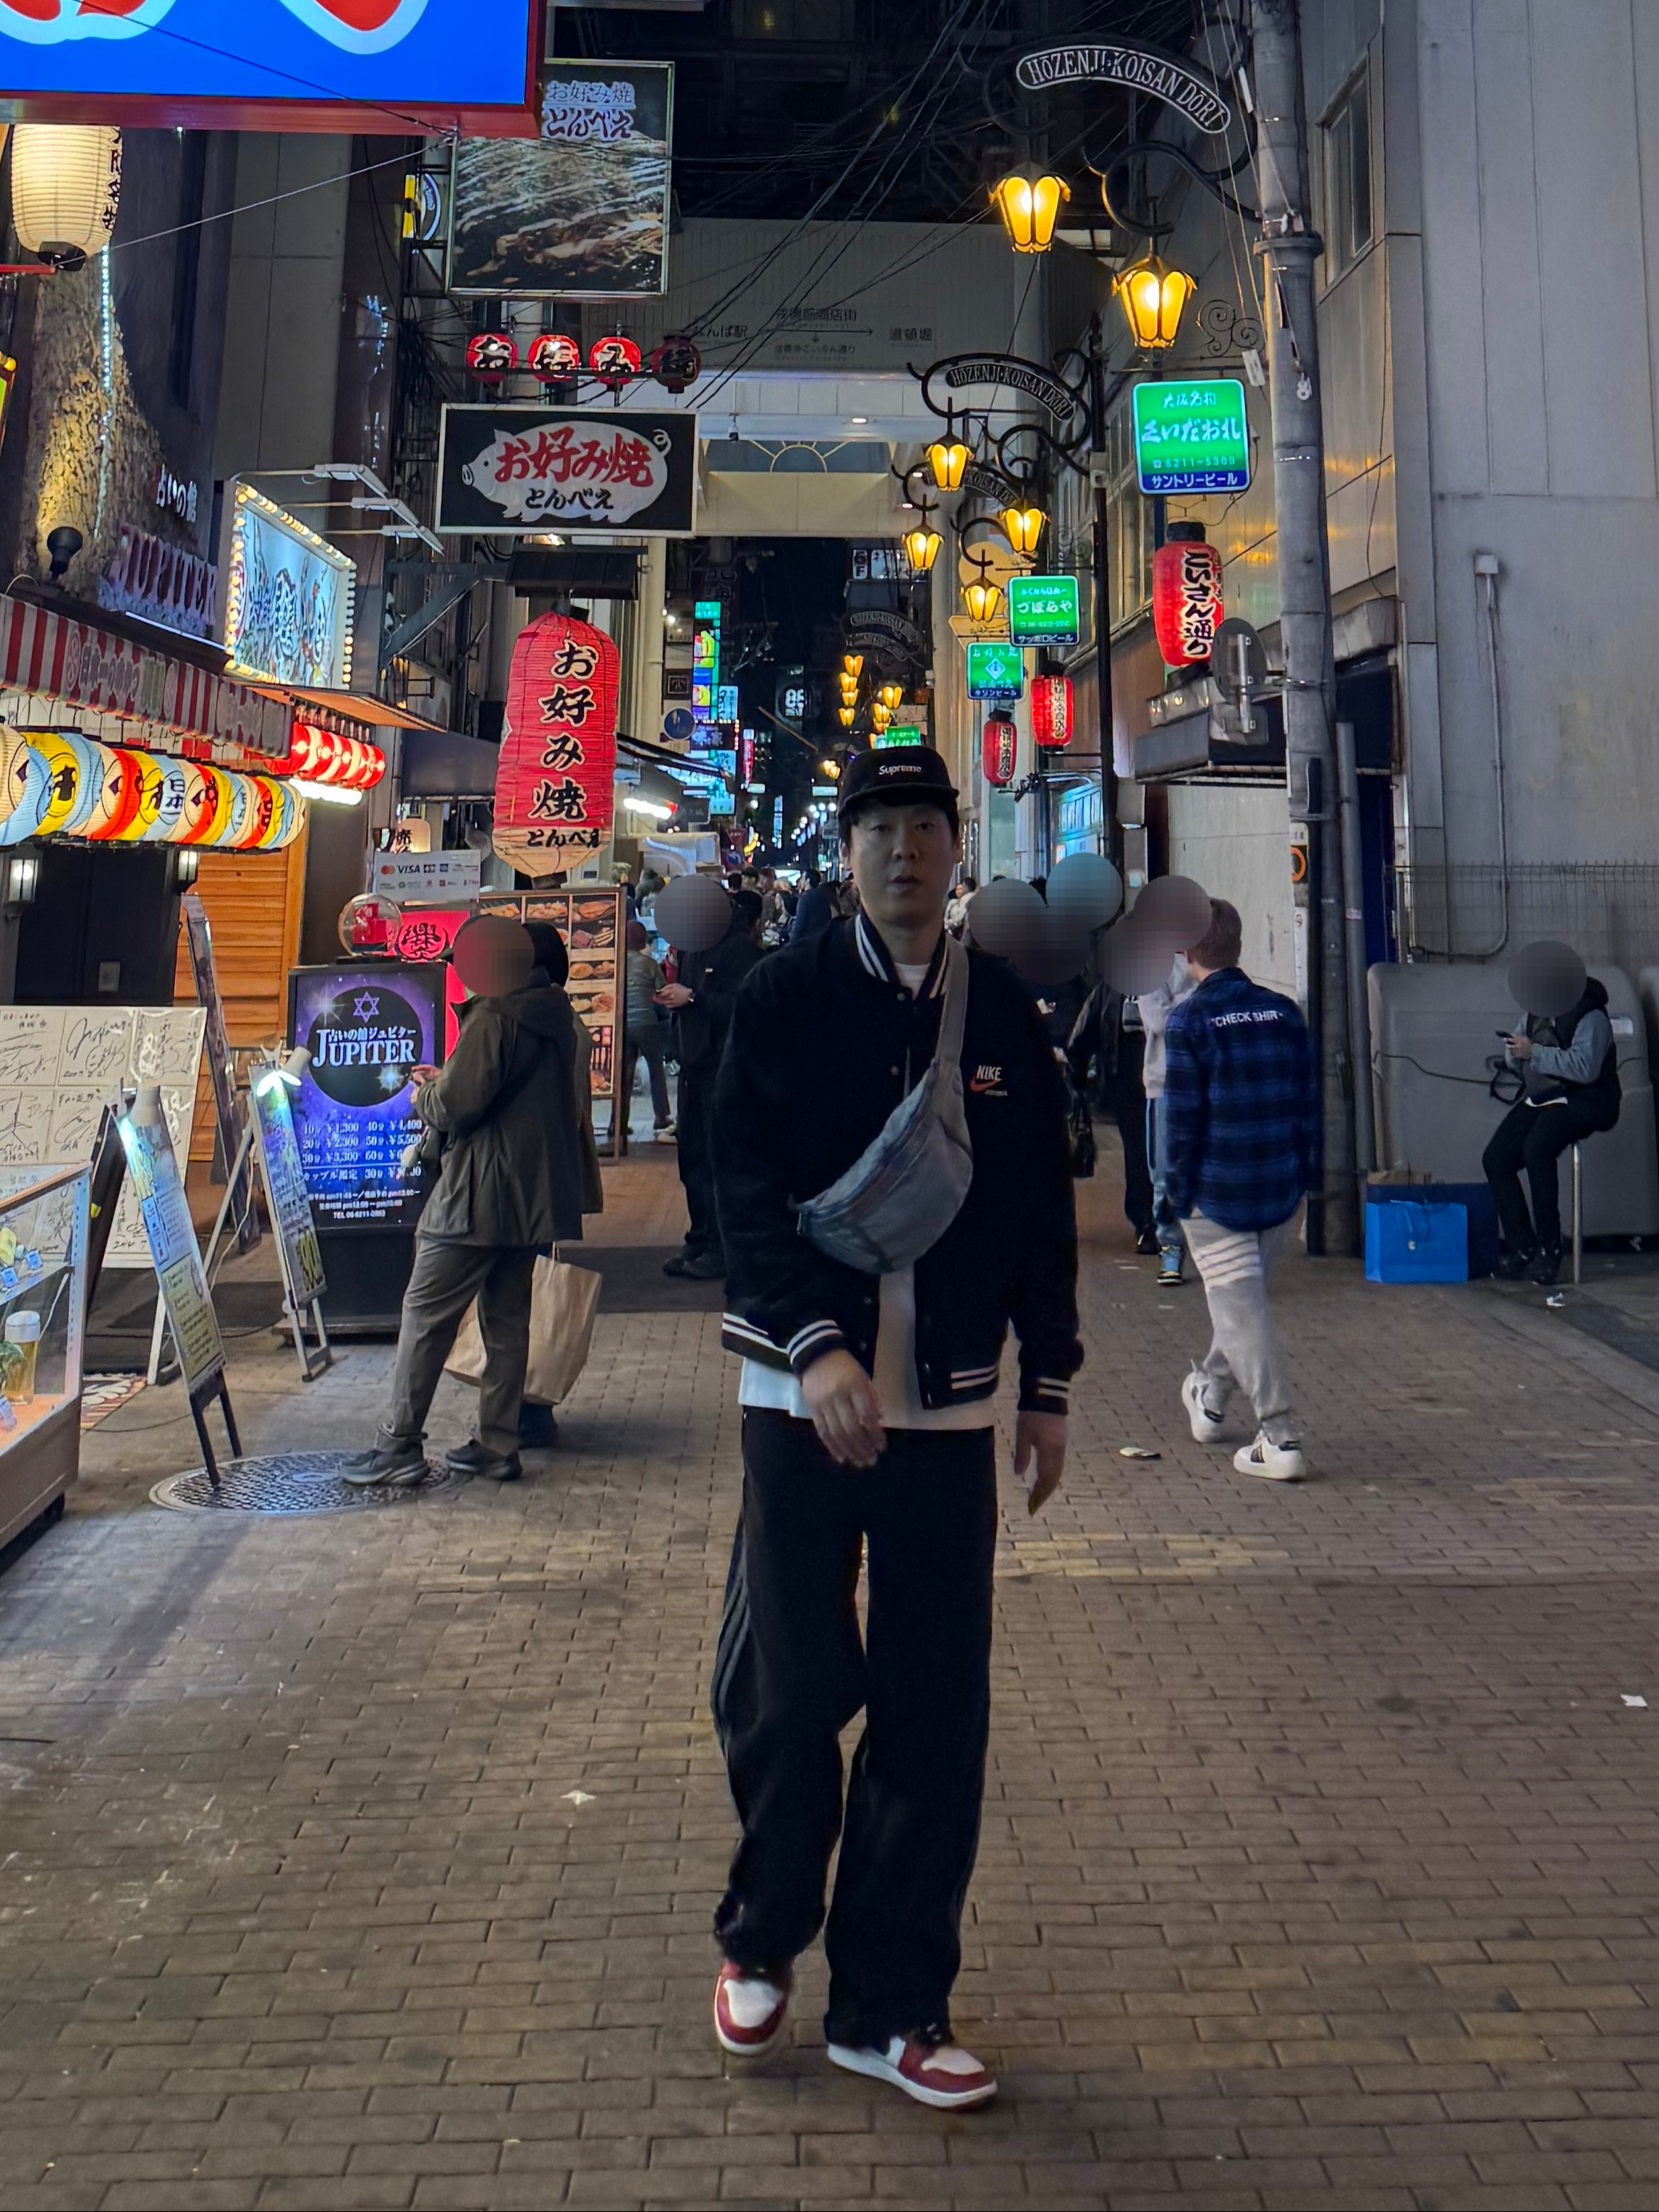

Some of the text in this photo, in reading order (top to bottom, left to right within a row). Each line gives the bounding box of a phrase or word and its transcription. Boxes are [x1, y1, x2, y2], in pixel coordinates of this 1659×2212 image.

[549, 82, 632, 103] お好み焼
[547, 109, 631, 138] とんべえ
[1163, 390, 1216, 409] 大阪名物
[1141, 417, 1242, 443] くいだおれ
[494, 426, 655, 488] お好み焼
[1152, 472, 1238, 488] サントリービール
[525, 488, 615, 510] とんべえ
[1184, 550, 1213, 655] こいさん通り
[529, 640, 599, 821] お好み焼
[878, 765, 922, 775] Supreme
[527, 829, 601, 848] とんべえ
[397, 864, 420, 874] VISA
[312, 1029, 416, 1067] JUPITER
[976, 1065, 1002, 1081] NIKE
